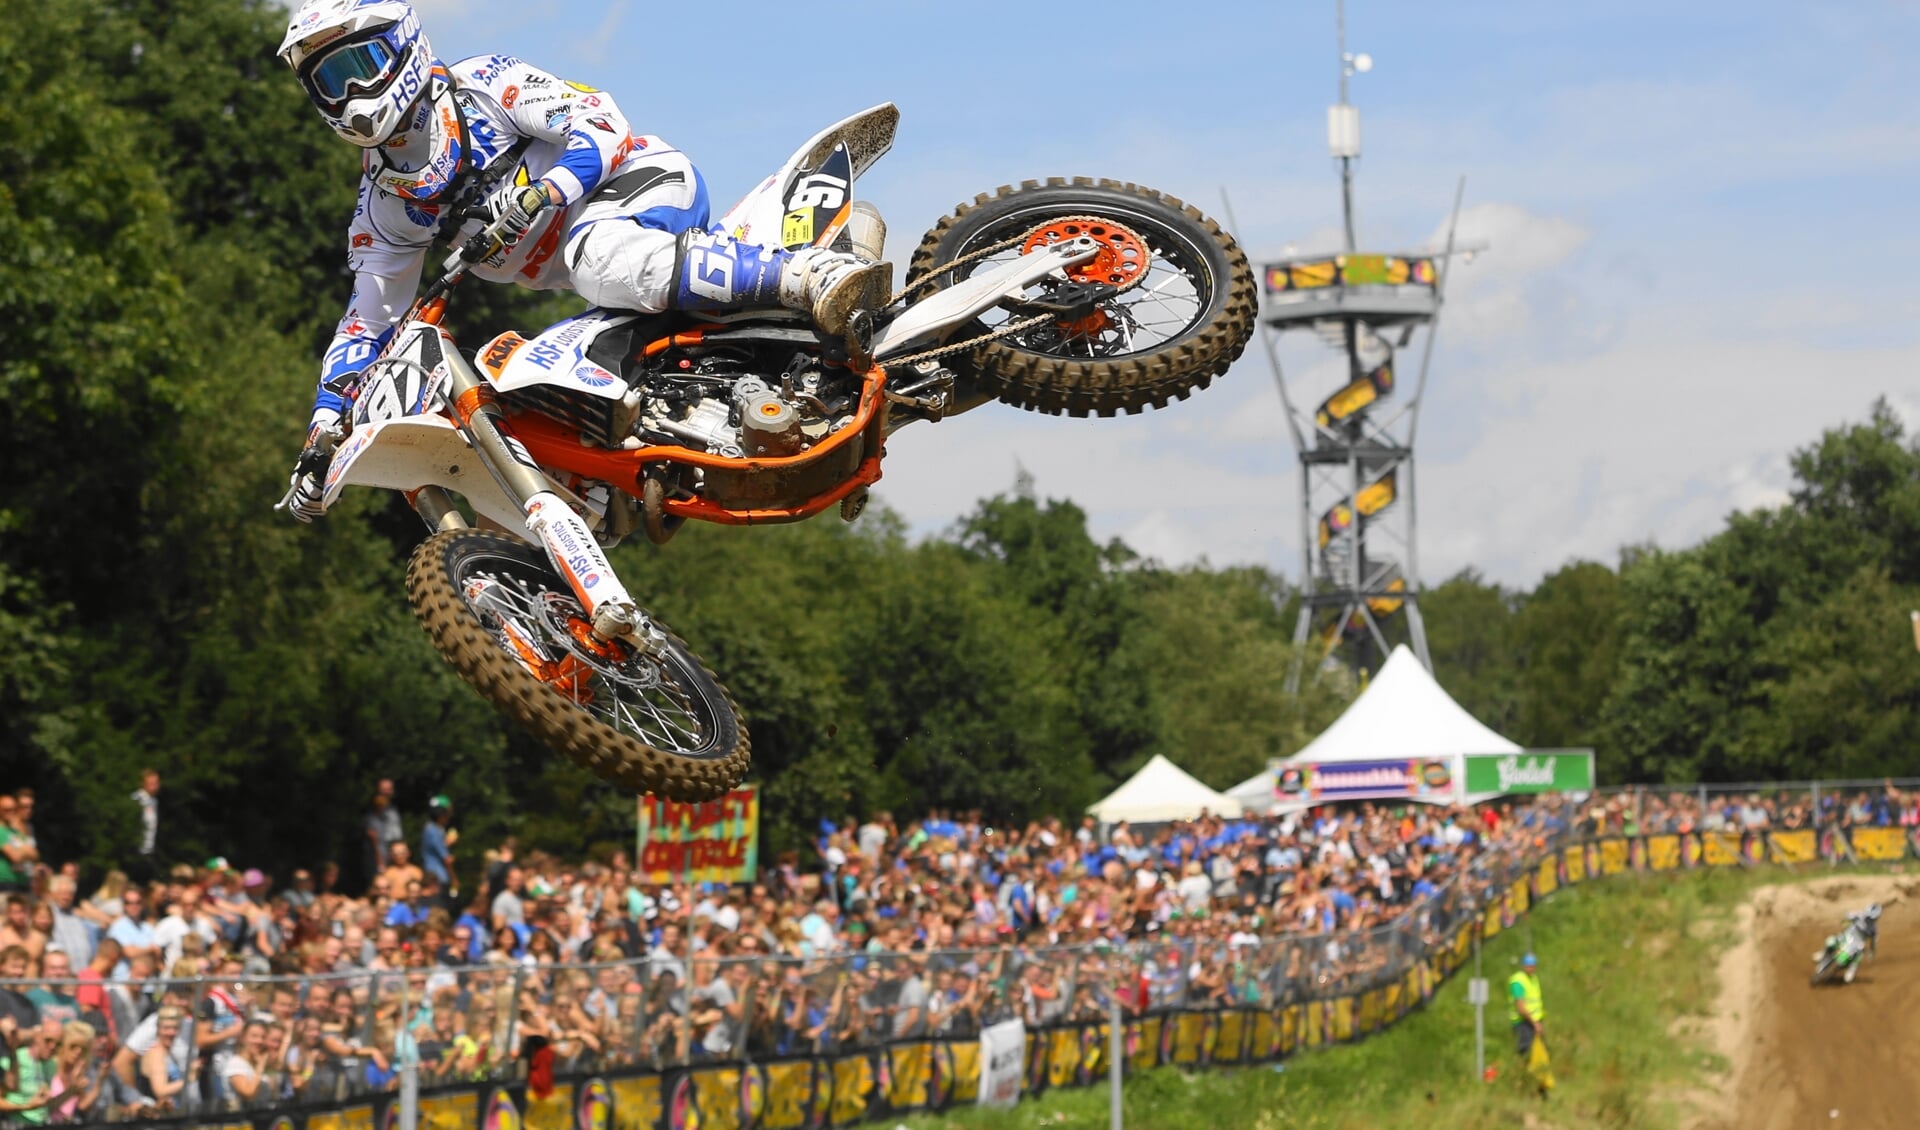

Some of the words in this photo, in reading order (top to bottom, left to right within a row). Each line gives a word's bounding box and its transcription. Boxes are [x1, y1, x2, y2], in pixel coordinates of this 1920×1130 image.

[391, 55, 422, 113] HSF
[415, 106, 428, 124] HSF
[431, 151, 449, 176] HSF
[788, 173, 848, 211] 97
[485, 336, 519, 370] KTM
[525, 340, 564, 370] HSF
[553, 317, 598, 347] LOGISTICS
[551, 520, 579, 555] LOGISTICS
[568, 518, 606, 568] DUNLOP
[568, 555, 593, 577] HSF
